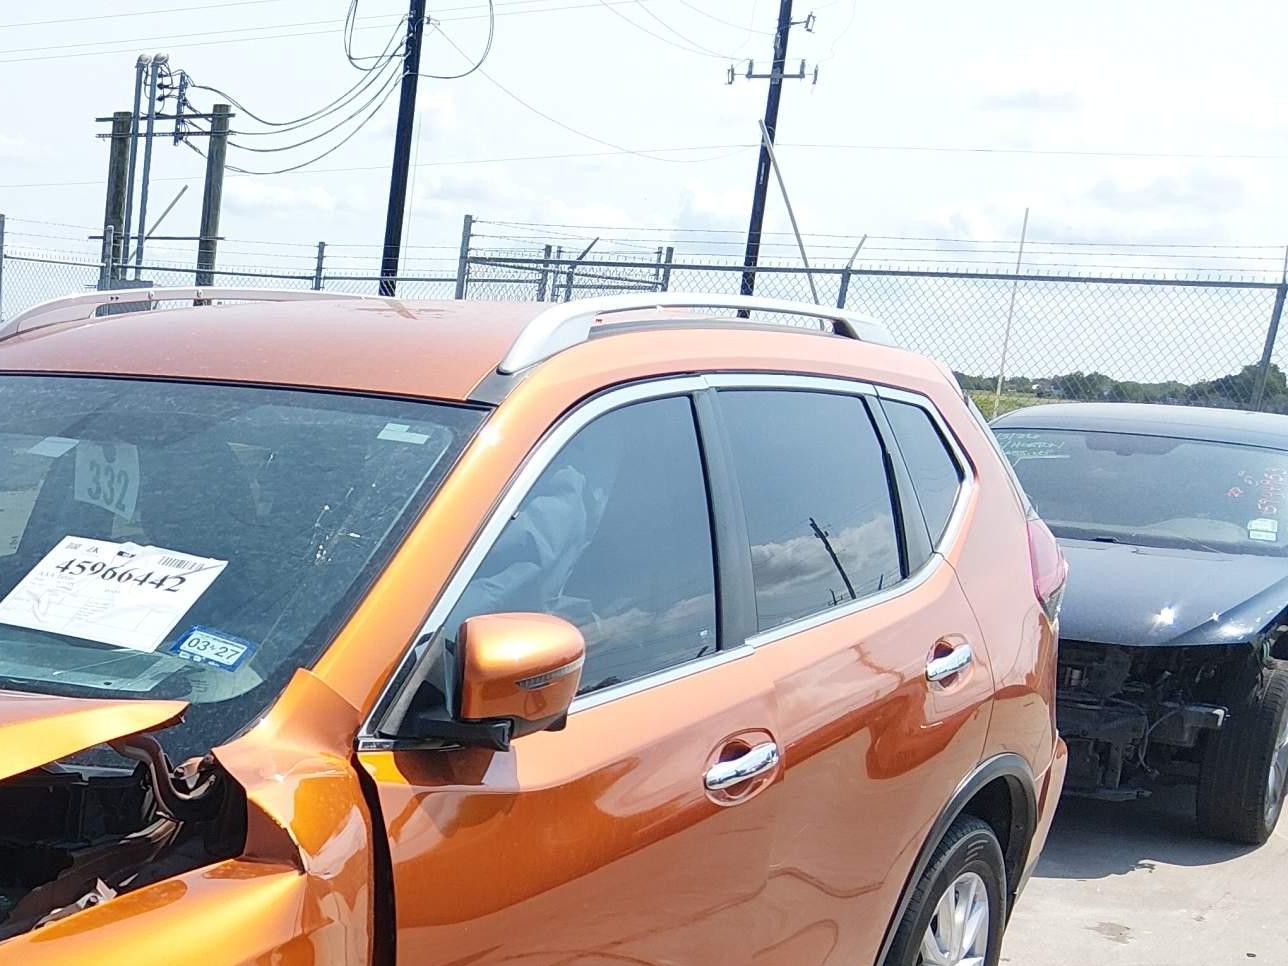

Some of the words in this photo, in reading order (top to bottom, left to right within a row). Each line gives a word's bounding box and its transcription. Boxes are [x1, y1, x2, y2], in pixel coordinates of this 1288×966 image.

[87, 459, 129, 513] 332
[55, 558, 187, 593] 45966442
[187, 637, 211, 651] 03
[214, 646, 241, 660] 27
